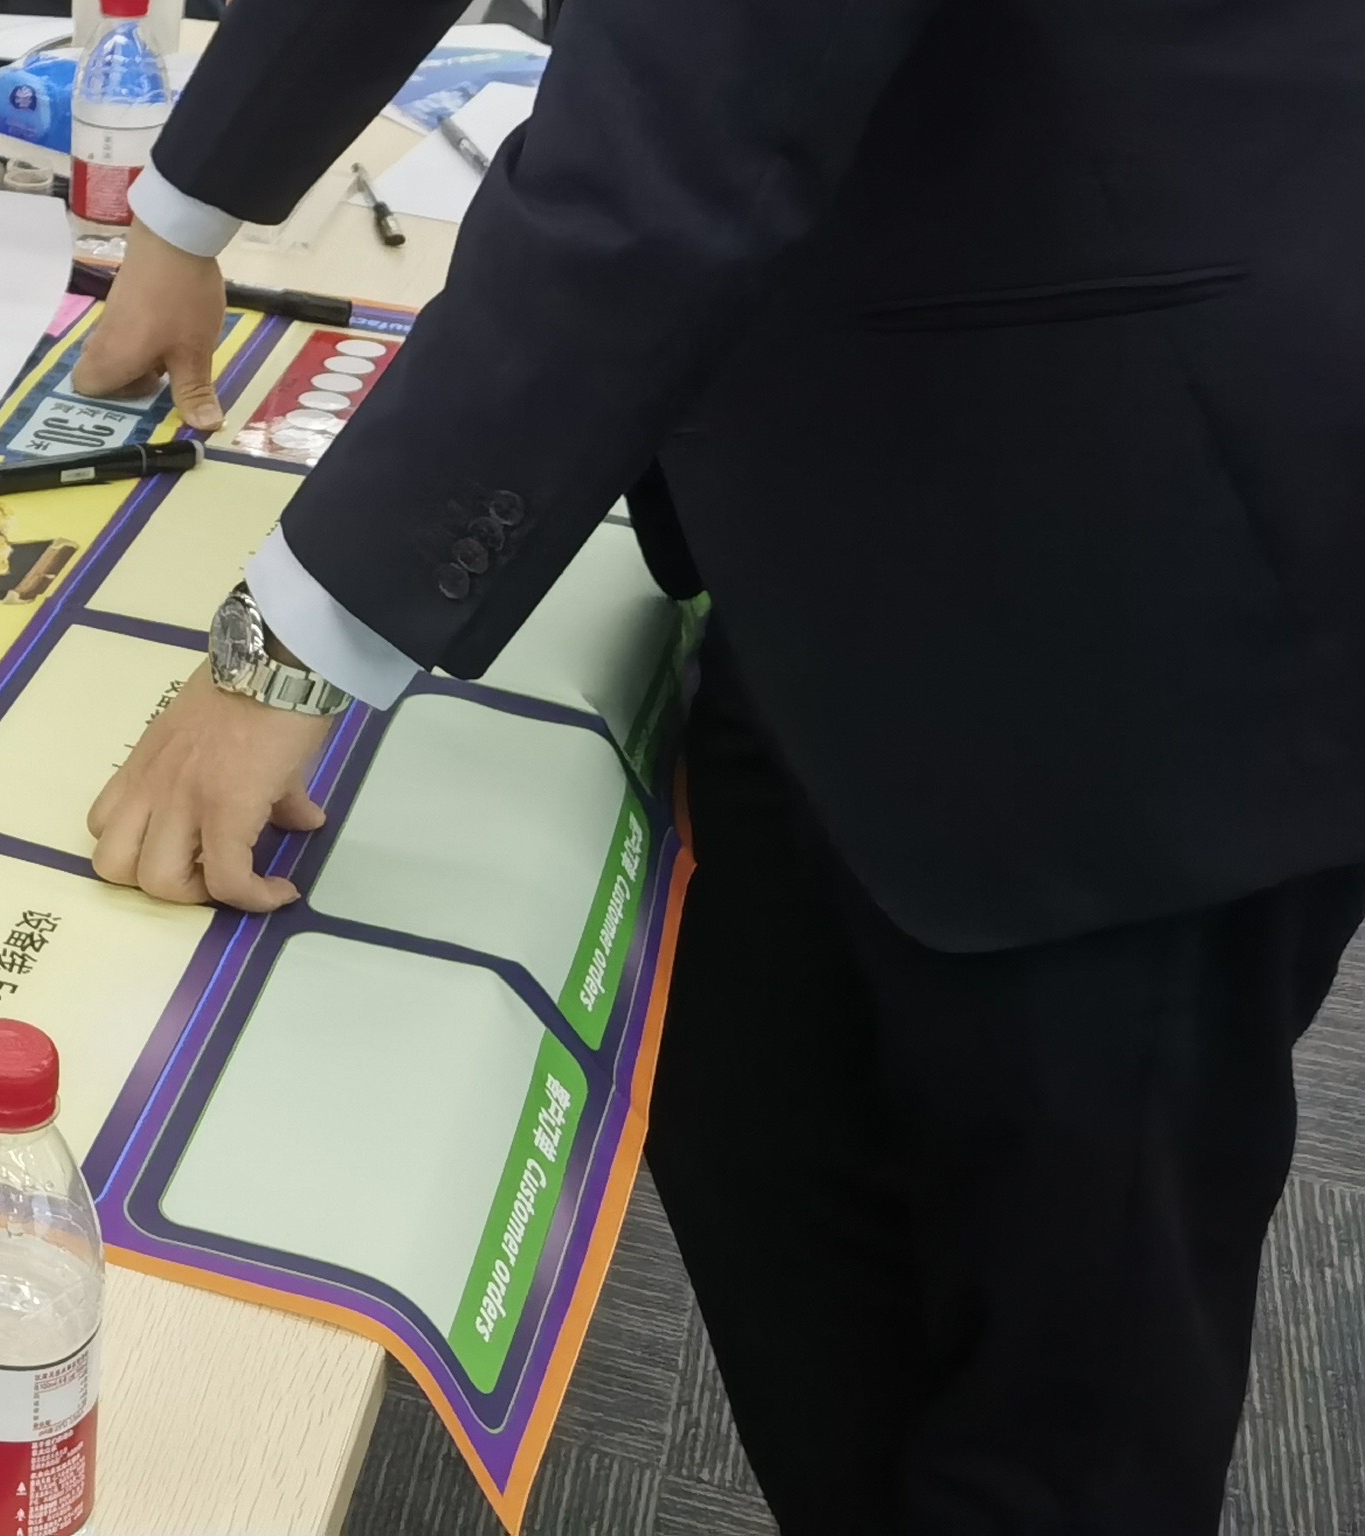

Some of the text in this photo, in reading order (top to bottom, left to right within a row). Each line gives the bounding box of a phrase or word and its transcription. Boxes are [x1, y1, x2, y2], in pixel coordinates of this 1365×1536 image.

[25, 419, 114, 451] 30 天
[598, 874, 632, 955] Customer
[578, 948, 607, 1012] orders
[473, 1073, 573, 1342] 客户订单 Customer orders
